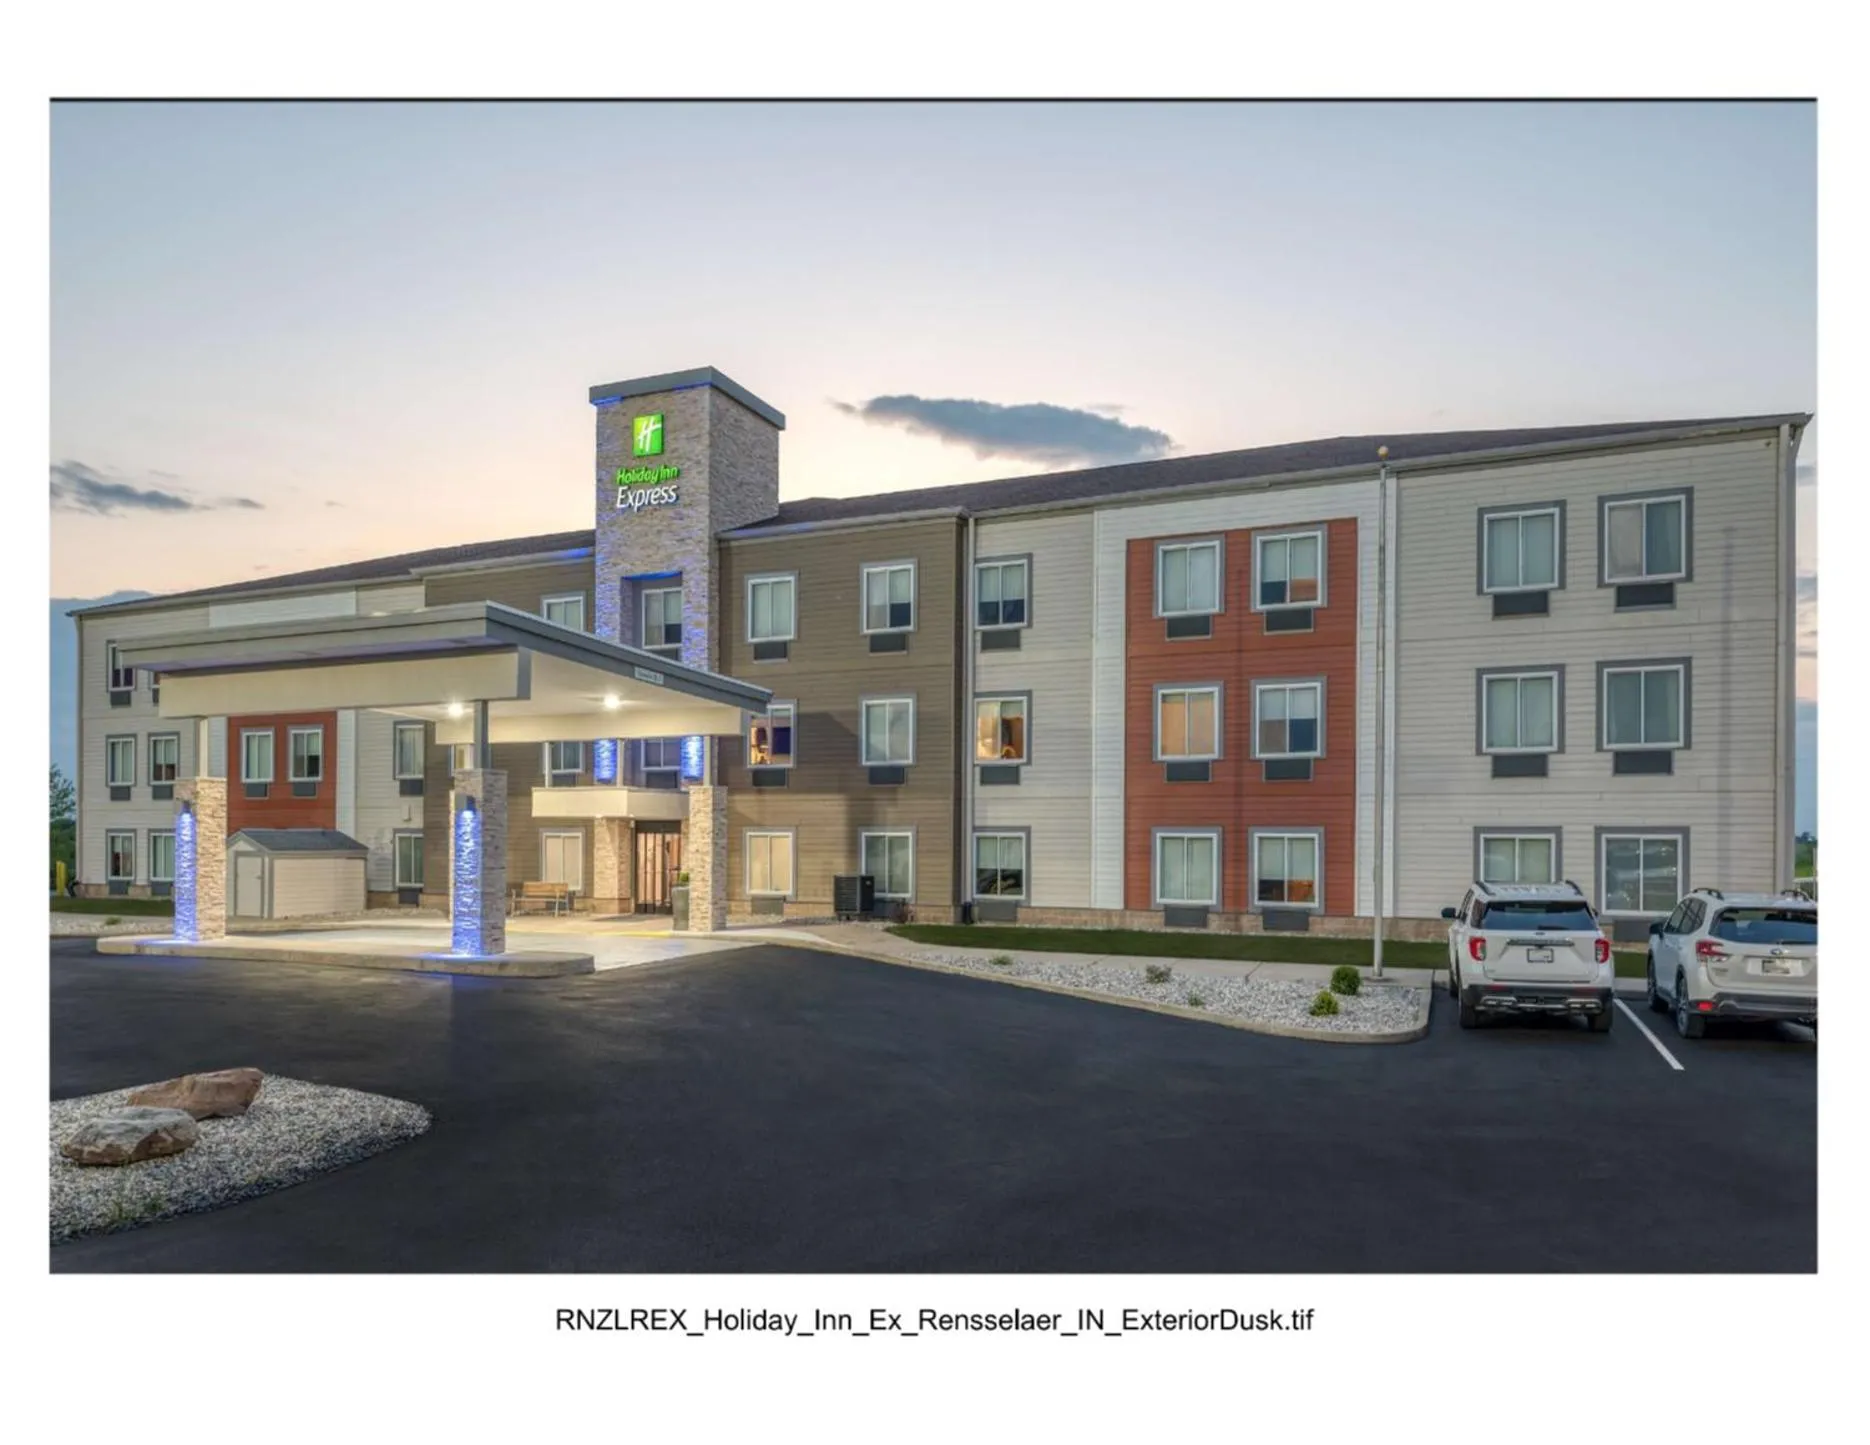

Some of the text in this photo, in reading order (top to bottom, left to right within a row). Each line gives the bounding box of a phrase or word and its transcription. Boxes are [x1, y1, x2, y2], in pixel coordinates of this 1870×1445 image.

[616, 464, 679, 485] Holiday Inn
[616, 484, 678, 512] Express
